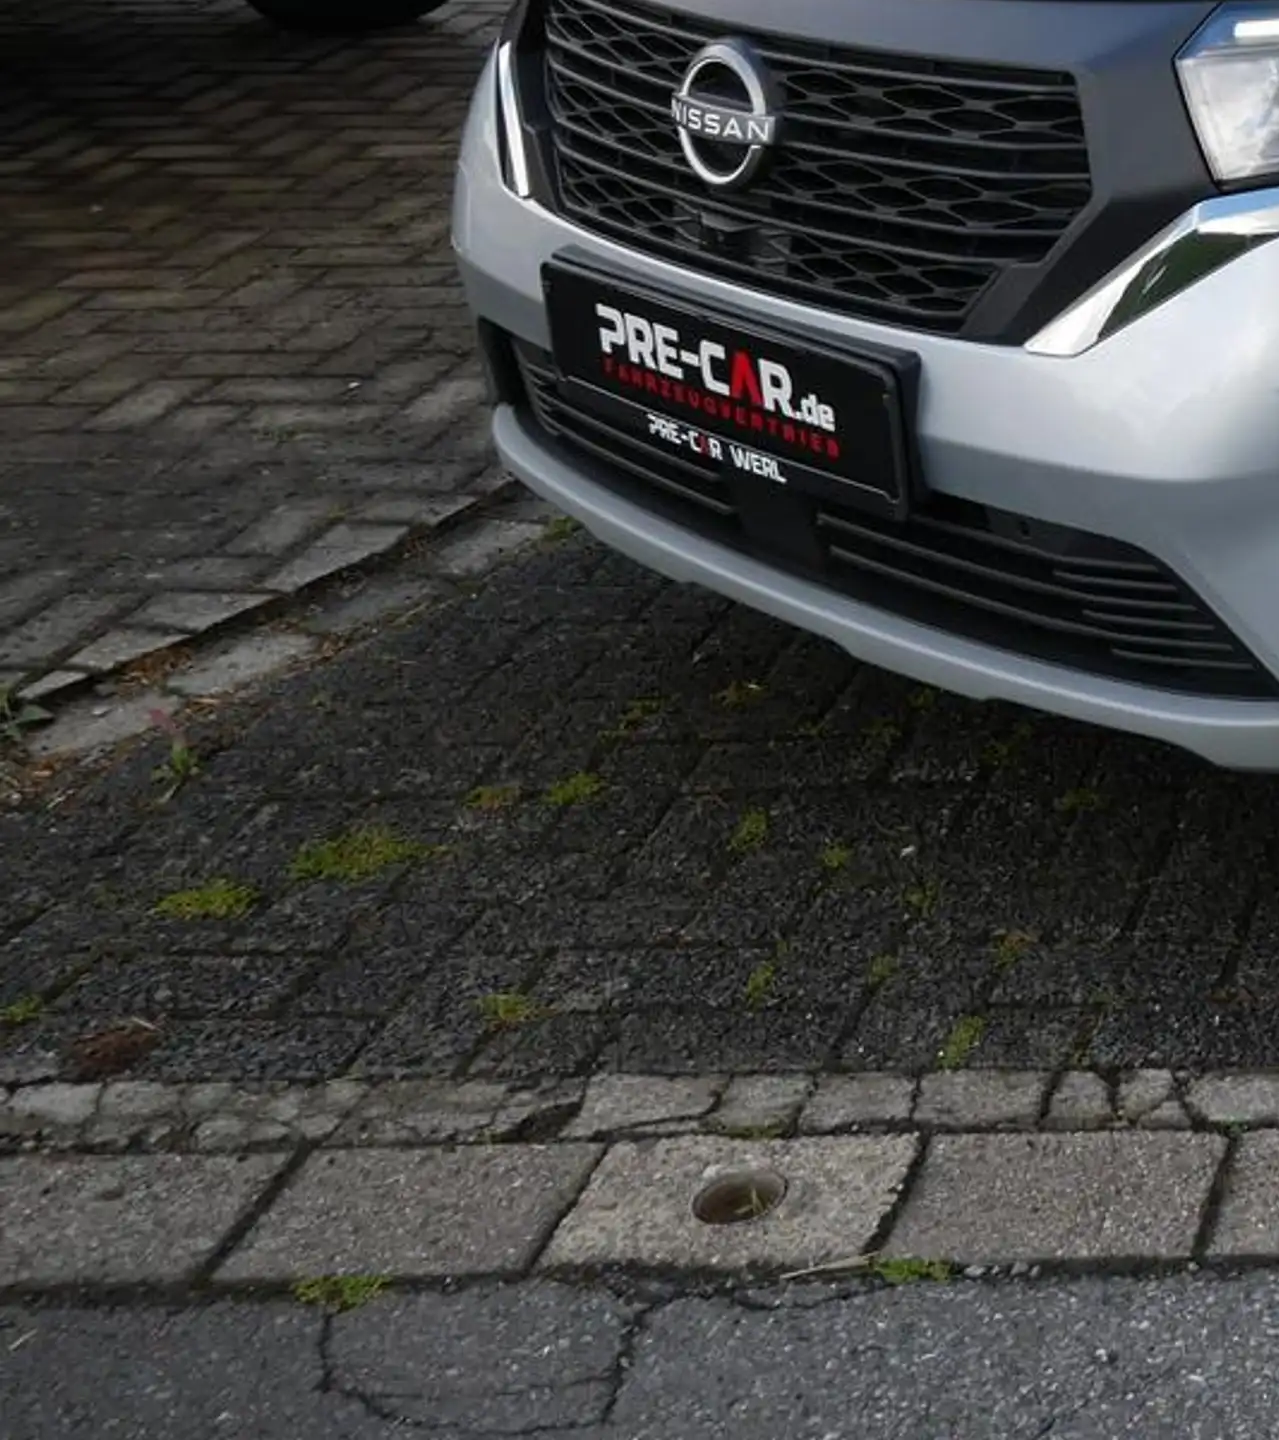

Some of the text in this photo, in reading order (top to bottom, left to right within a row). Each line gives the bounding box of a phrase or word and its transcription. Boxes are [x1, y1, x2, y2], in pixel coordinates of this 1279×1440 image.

[671, 97, 769, 142] NISSAN
[595, 303, 836, 432] PRE-CAR.de
[647, 413, 788, 483] PRE-CAR WERL
